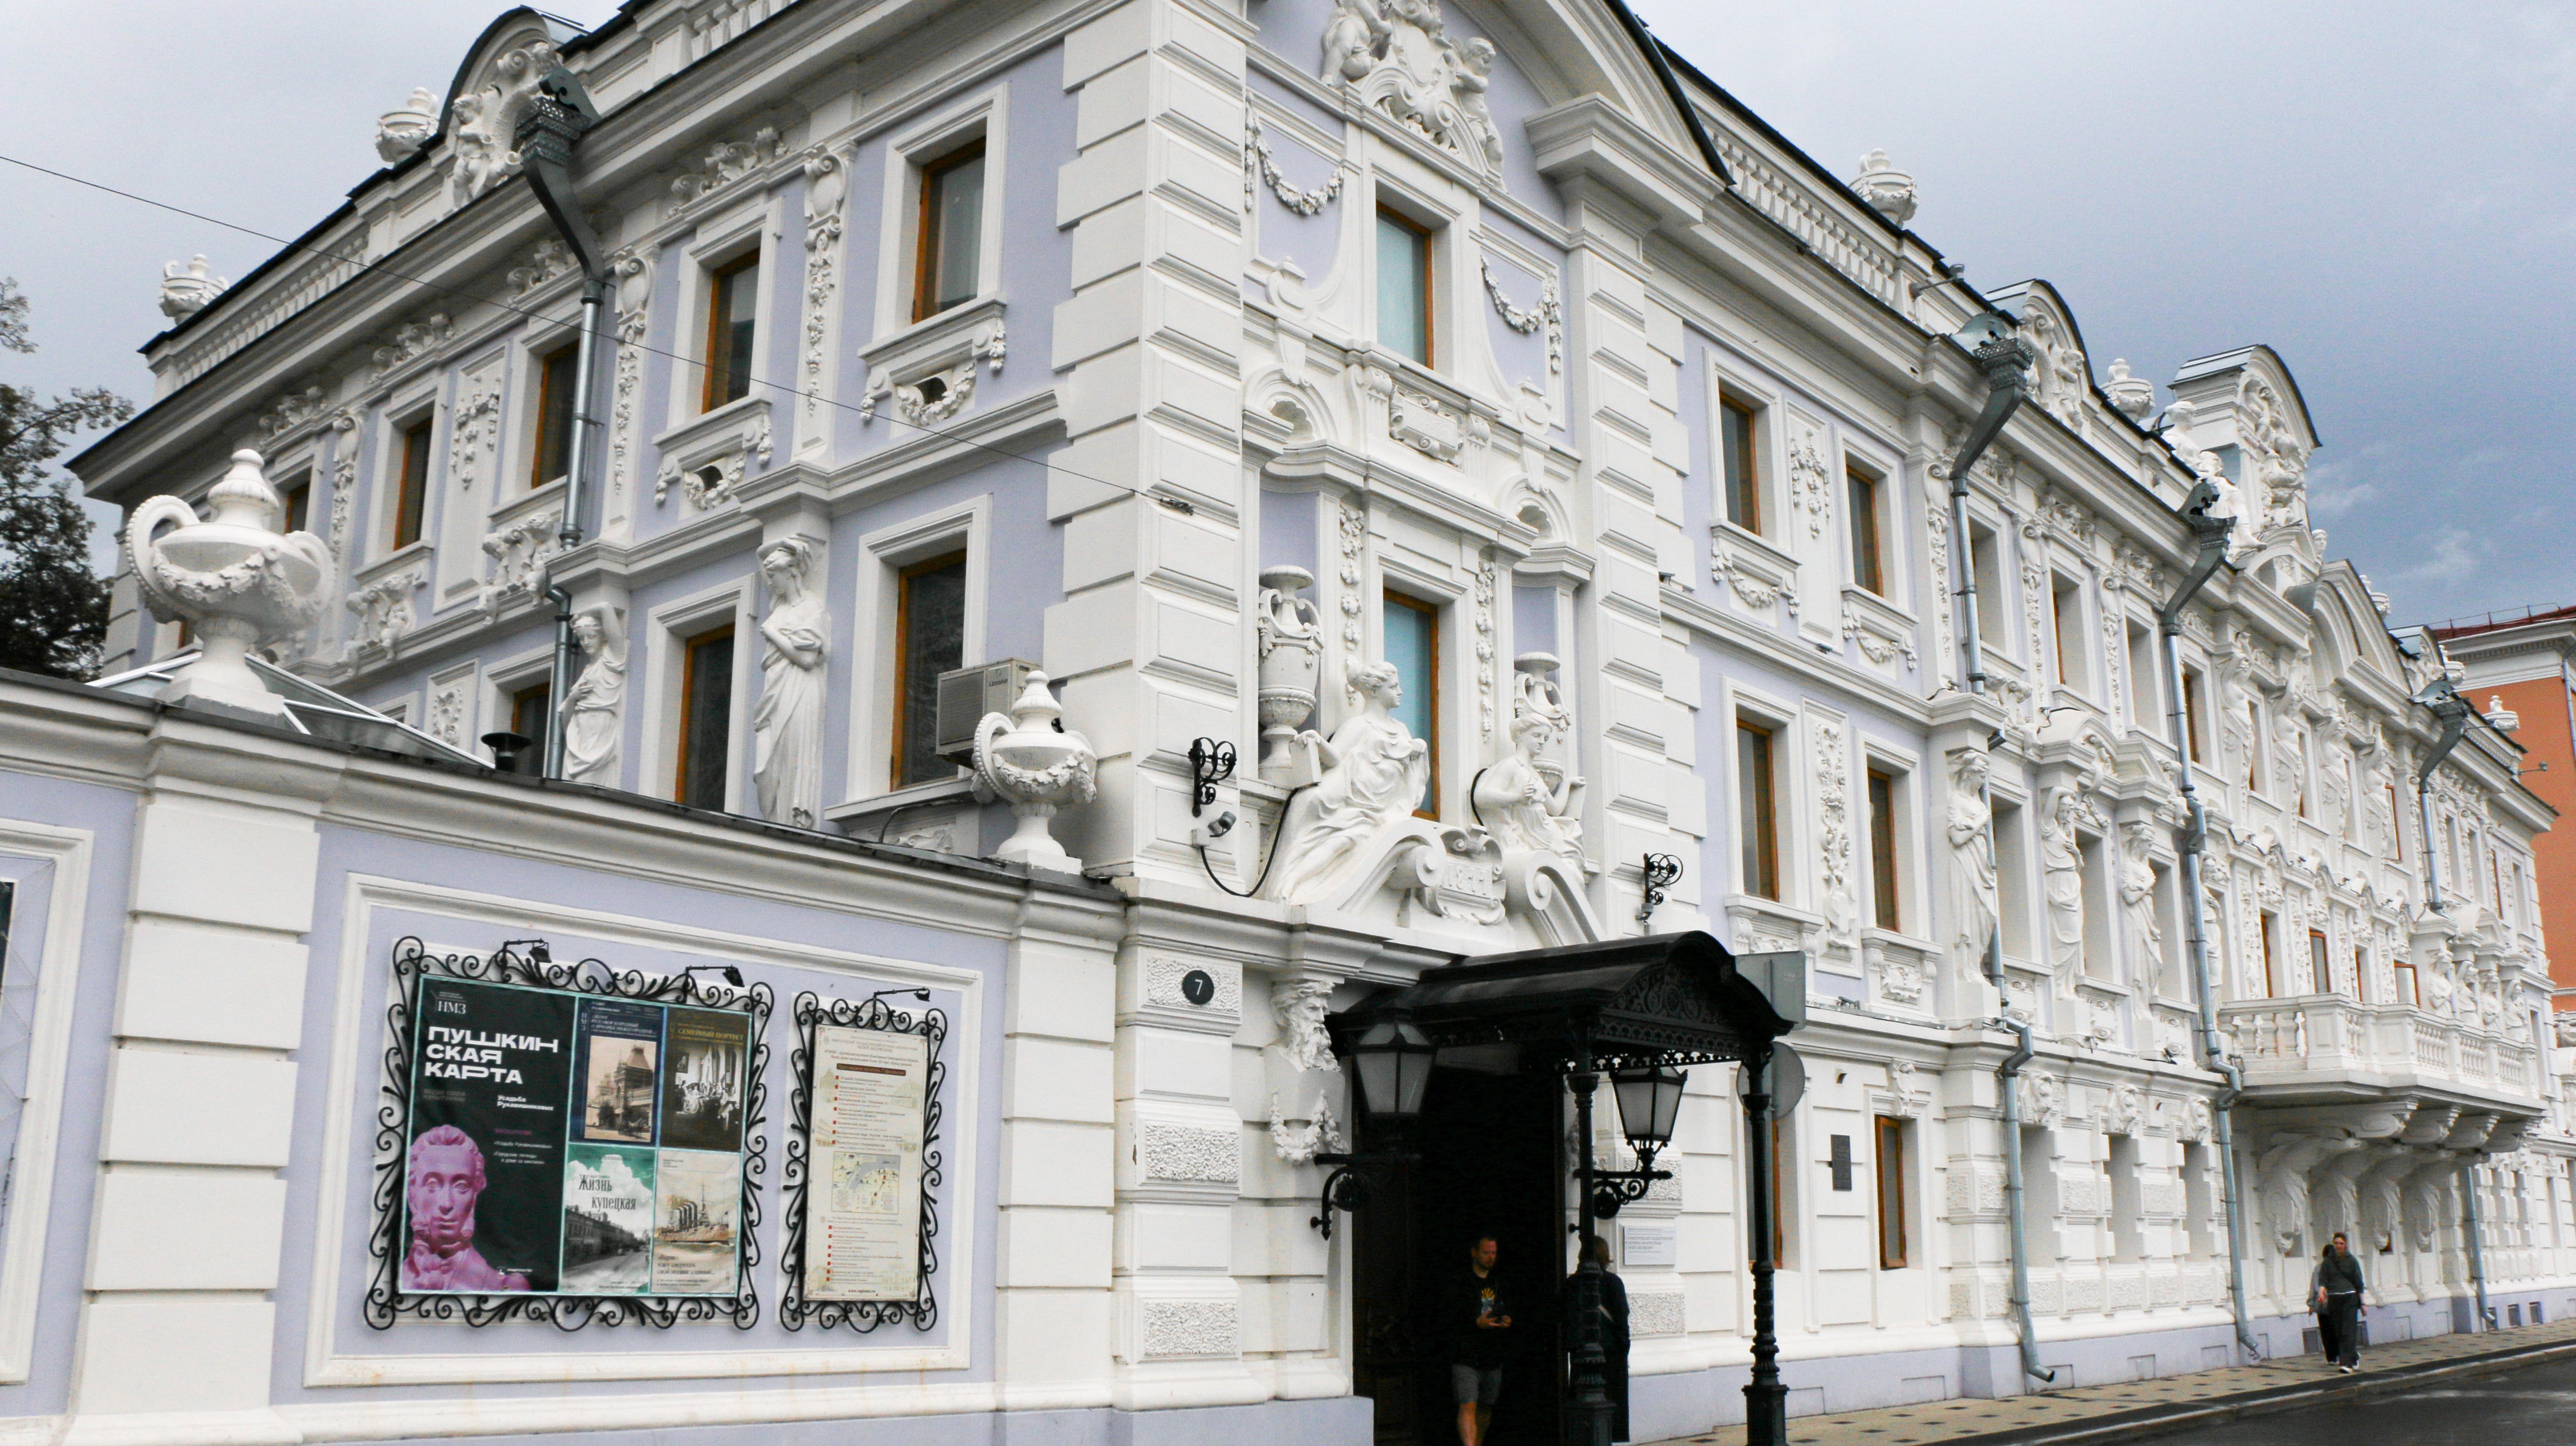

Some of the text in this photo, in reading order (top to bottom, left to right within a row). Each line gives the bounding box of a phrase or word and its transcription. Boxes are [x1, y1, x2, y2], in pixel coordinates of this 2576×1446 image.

[1195, 979, 1203, 995] 7
[438, 1001, 466, 1014] НМЗ
[428, 1026, 559, 1053] ПУШКИН
[426, 1044, 502, 1065] СКАЯ
[425, 1062, 523, 1084] КАРТА
[578, 1174, 612, 1192] Жизнь
[592, 1197, 636, 1212] купецкая
